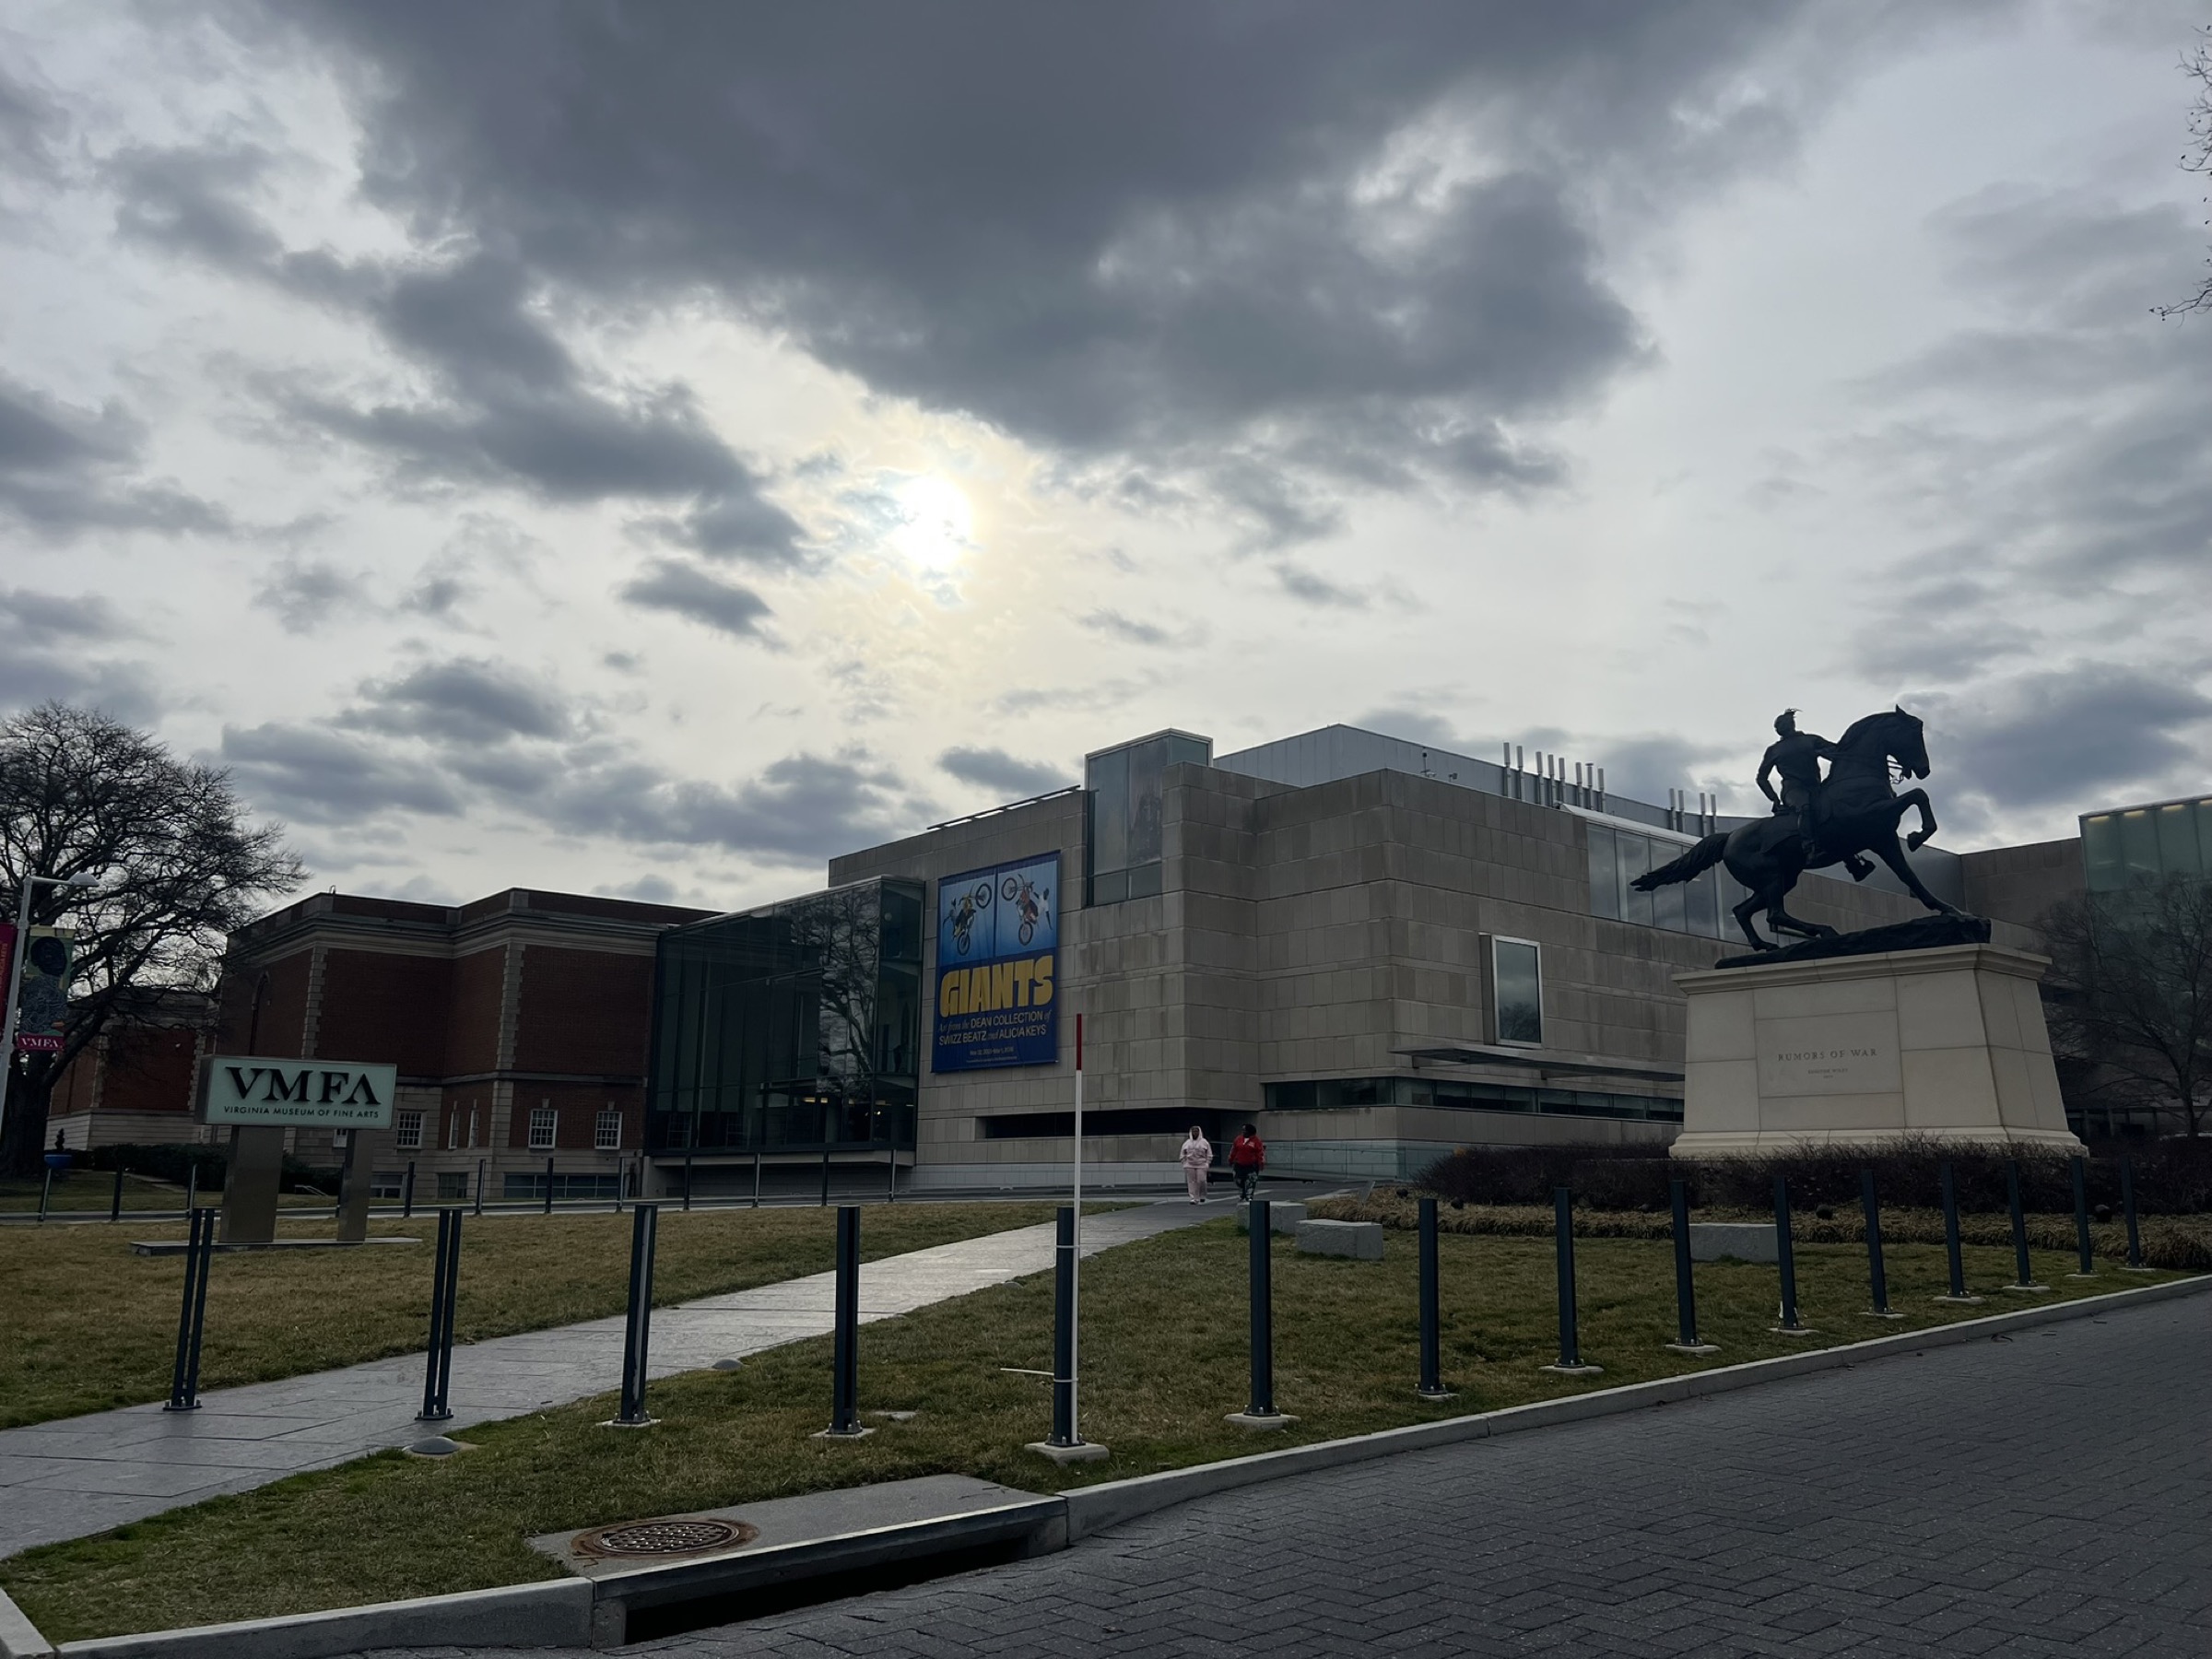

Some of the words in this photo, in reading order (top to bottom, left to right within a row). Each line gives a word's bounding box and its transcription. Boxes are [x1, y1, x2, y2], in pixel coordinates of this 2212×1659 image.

[939, 955, 1053, 1018] GIANTS
[947, 1020, 961, 1034] from
[971, 1017, 992, 1029] DEAN
[993, 1010, 1043, 1026] COLLECTION
[1044, 1009, 1052, 1023] of
[21, 1037, 59, 1048] VMFA
[938, 1033, 961, 1046] SWIZZ
[962, 1030, 987, 1042] BEATZ
[998, 1027, 1025, 1040] ALICIA
[1025, 1024, 1047, 1036] KEYS
[1778, 1051, 1825, 1062] RUMORS
[1830, 1050, 1845, 1058] OF
[1851, 1048, 1877, 1057] WAR
[224, 1066, 382, 1105] VMFA
[224, 1106, 270, 1115] VIRGINIA
[273, 1107, 315, 1116] MUSEUM
[317, 1108, 330, 1117] OF
[334, 1109, 353, 1118] FINE
[357, 1110, 379, 1119] ARTS
